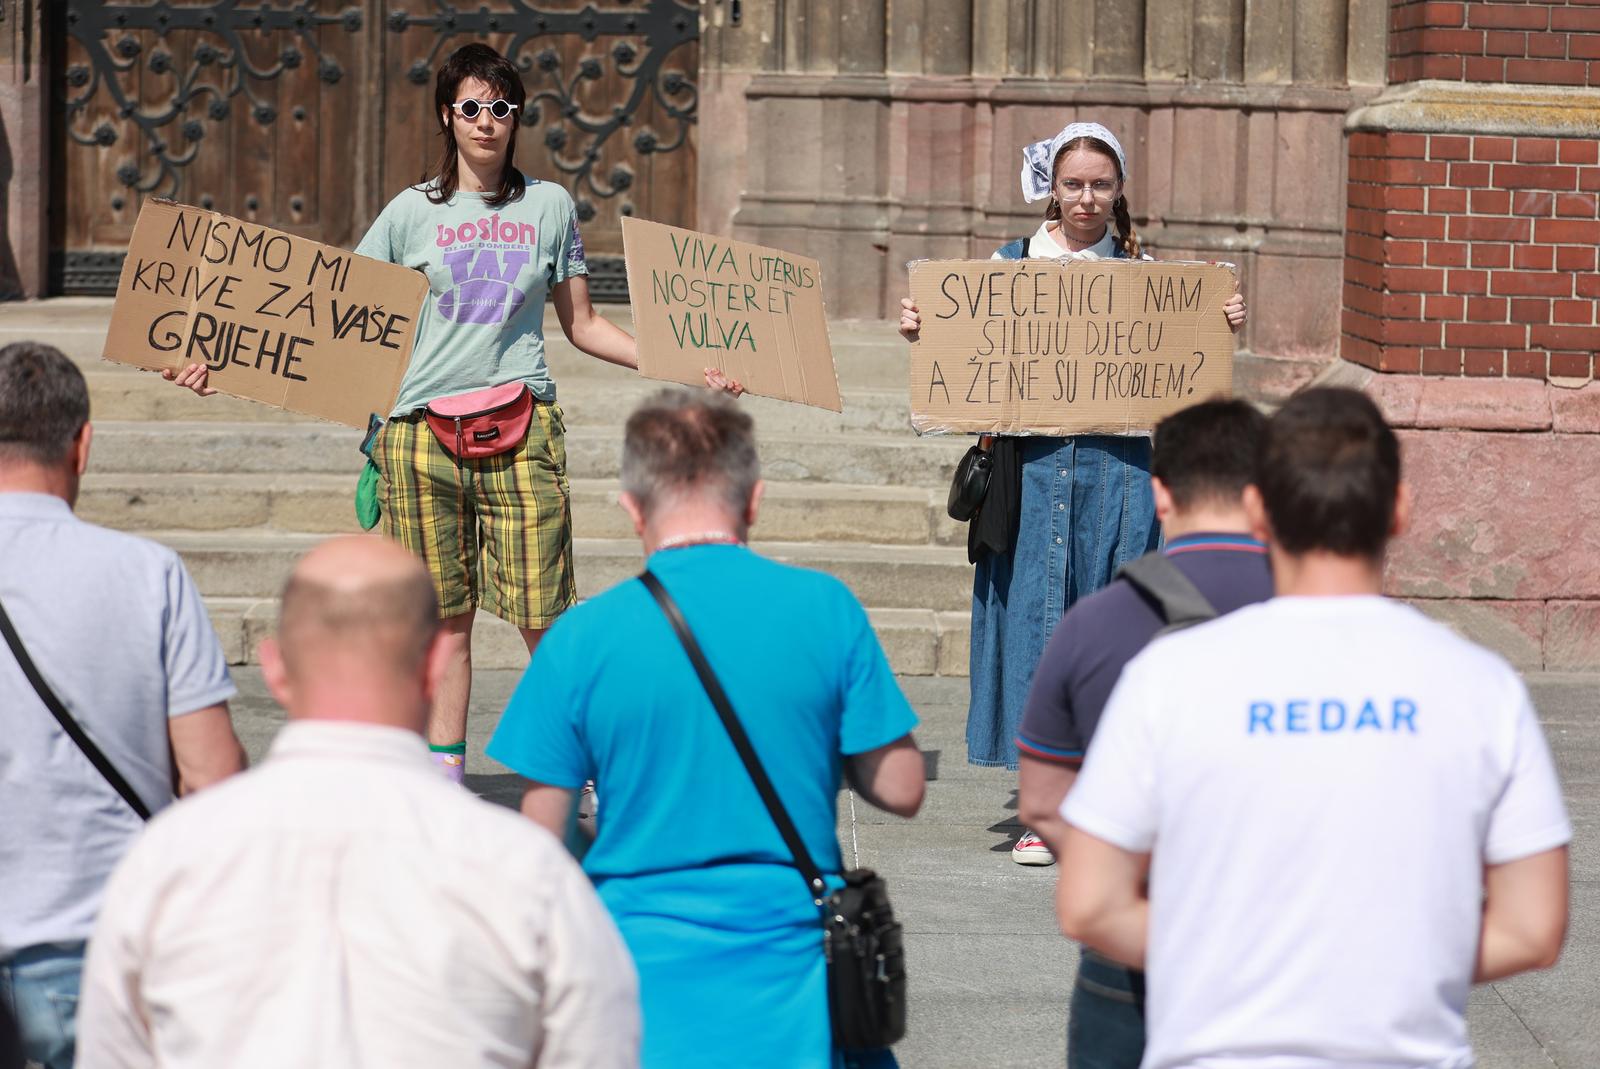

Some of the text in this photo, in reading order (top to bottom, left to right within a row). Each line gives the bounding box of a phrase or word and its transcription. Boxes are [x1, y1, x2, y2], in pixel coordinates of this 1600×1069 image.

[167, 211, 351, 292] NISMO MI
[435, 213, 536, 247] boston
[671, 233, 814, 288] VIVA UTERUS
[132, 259, 410, 349] KRIVE ZA VAŠE
[652, 270, 796, 315] NOSTER ET
[936, 265, 1203, 319] SVEĆENICI NAM
[148, 311, 315, 381] GRIJEHE
[669, 312, 757, 352] VULVA
[977, 320, 1163, 356] SILUJU DJECU
[929, 352, 1204, 404] A ŽENE SU PROBLEM?
[1247, 698, 1417, 733] REDAR
